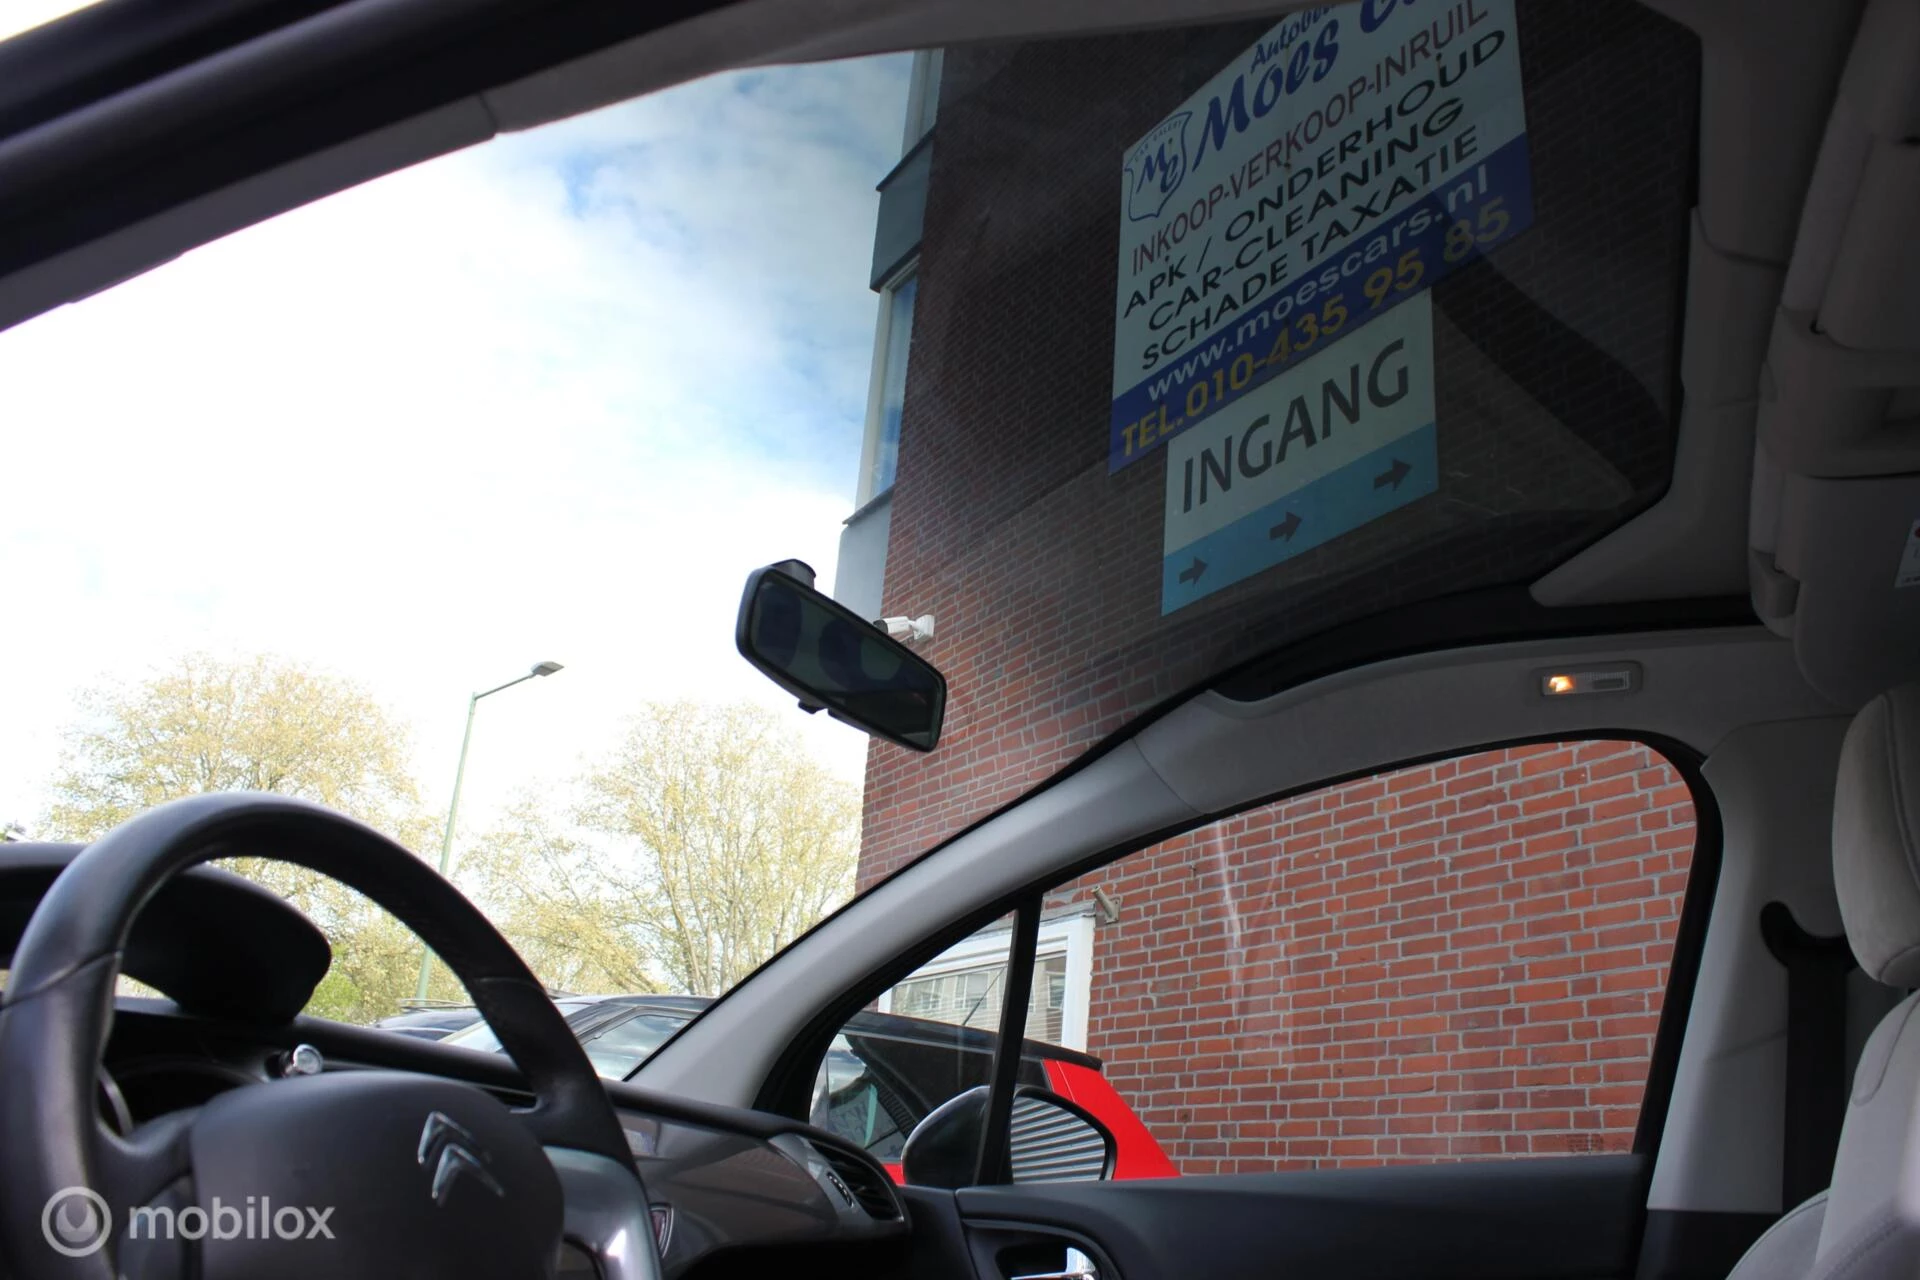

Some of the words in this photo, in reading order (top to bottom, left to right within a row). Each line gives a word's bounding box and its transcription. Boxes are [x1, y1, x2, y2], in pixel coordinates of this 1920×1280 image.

[1123, 257, 1187, 318] APK
[1225, 30, 1505, 242] ONDERHOUD
[1132, 0, 1488, 276] INKOOP-VERKOOP-INRUIL
[1192, 19, 1340, 172] Moes
[1142, 255, 1289, 370] SCHADE
[1301, 125, 1478, 262] TAXATIE
[1148, 97, 1464, 331] CAR-CLEANING
[1148, 164, 1487, 401] www.moescars.nl
[1363, 248, 1424, 310] 95
[1443, 195, 1512, 263] 85
[1183, 339, 1410, 513] INGANG
